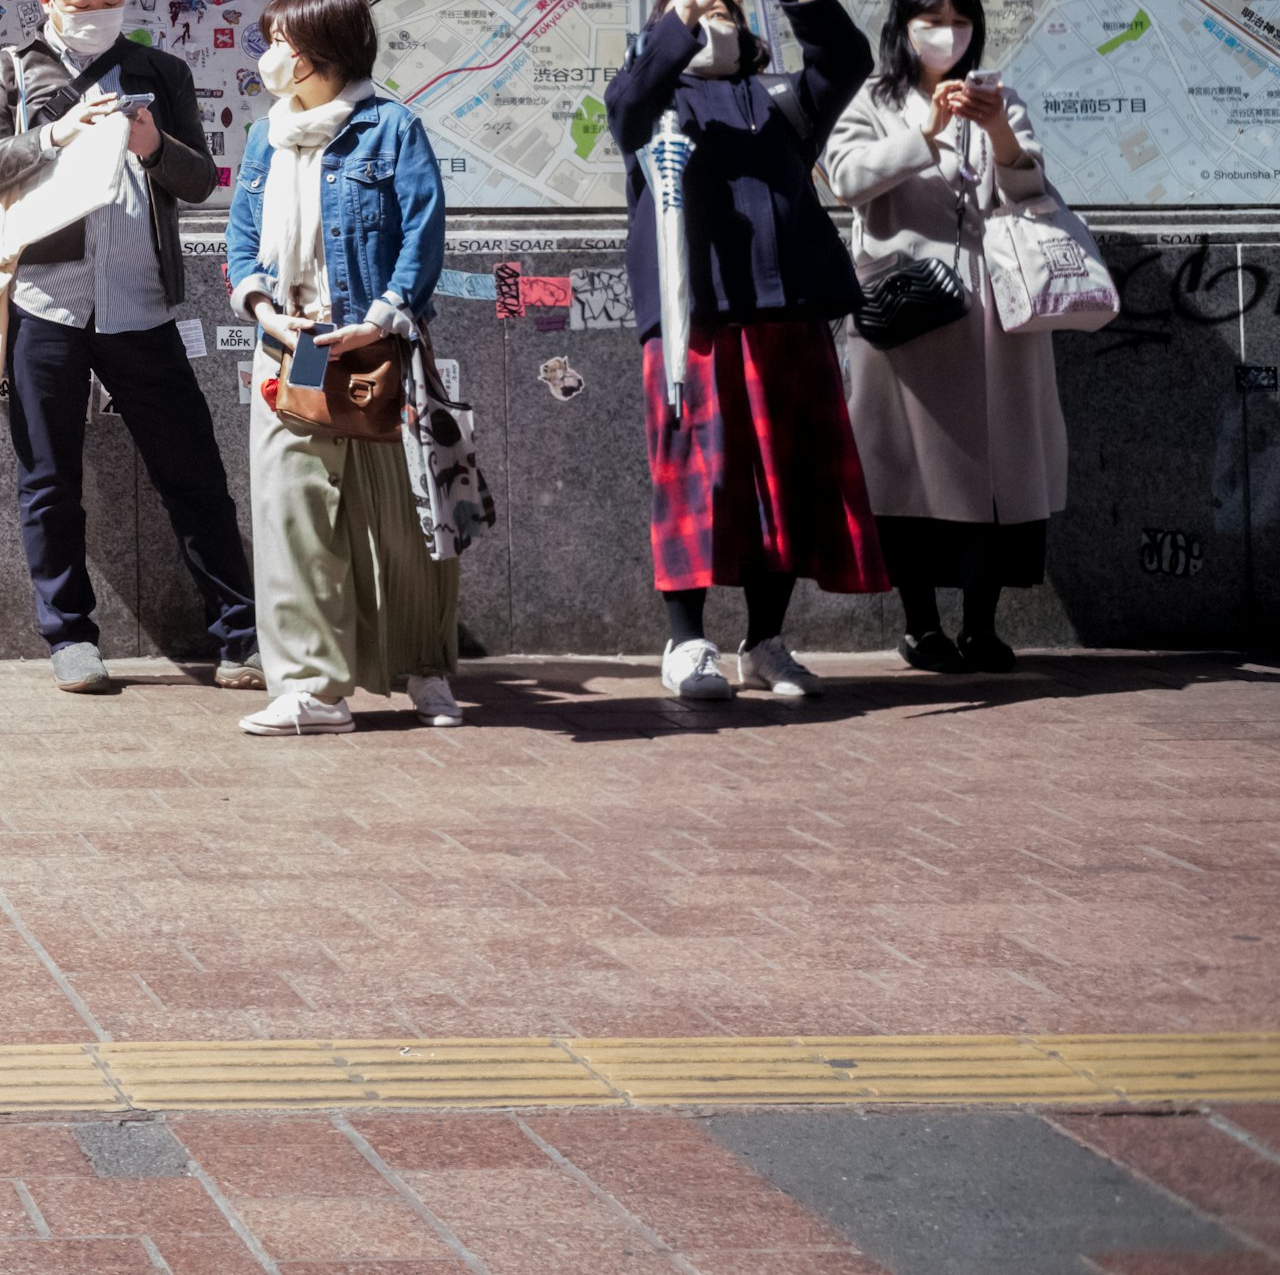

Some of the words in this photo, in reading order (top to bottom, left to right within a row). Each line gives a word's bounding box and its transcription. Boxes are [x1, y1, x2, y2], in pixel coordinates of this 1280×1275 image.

[388, 41, 427, 51] 東急ステイ
[532, 67, 619, 83] 渋谷3丁目
[1043, 97, 1147, 114] 神宮前5丁目
[1214, 169, 1272, 180] Shobunsha
[183, 242, 228, 255] SOAR
[458, 239, 504, 252] SOAR
[508, 239, 554, 252] SOAR
[228, 329, 243, 338] ZC
[220, 338, 252, 348] MDFK
